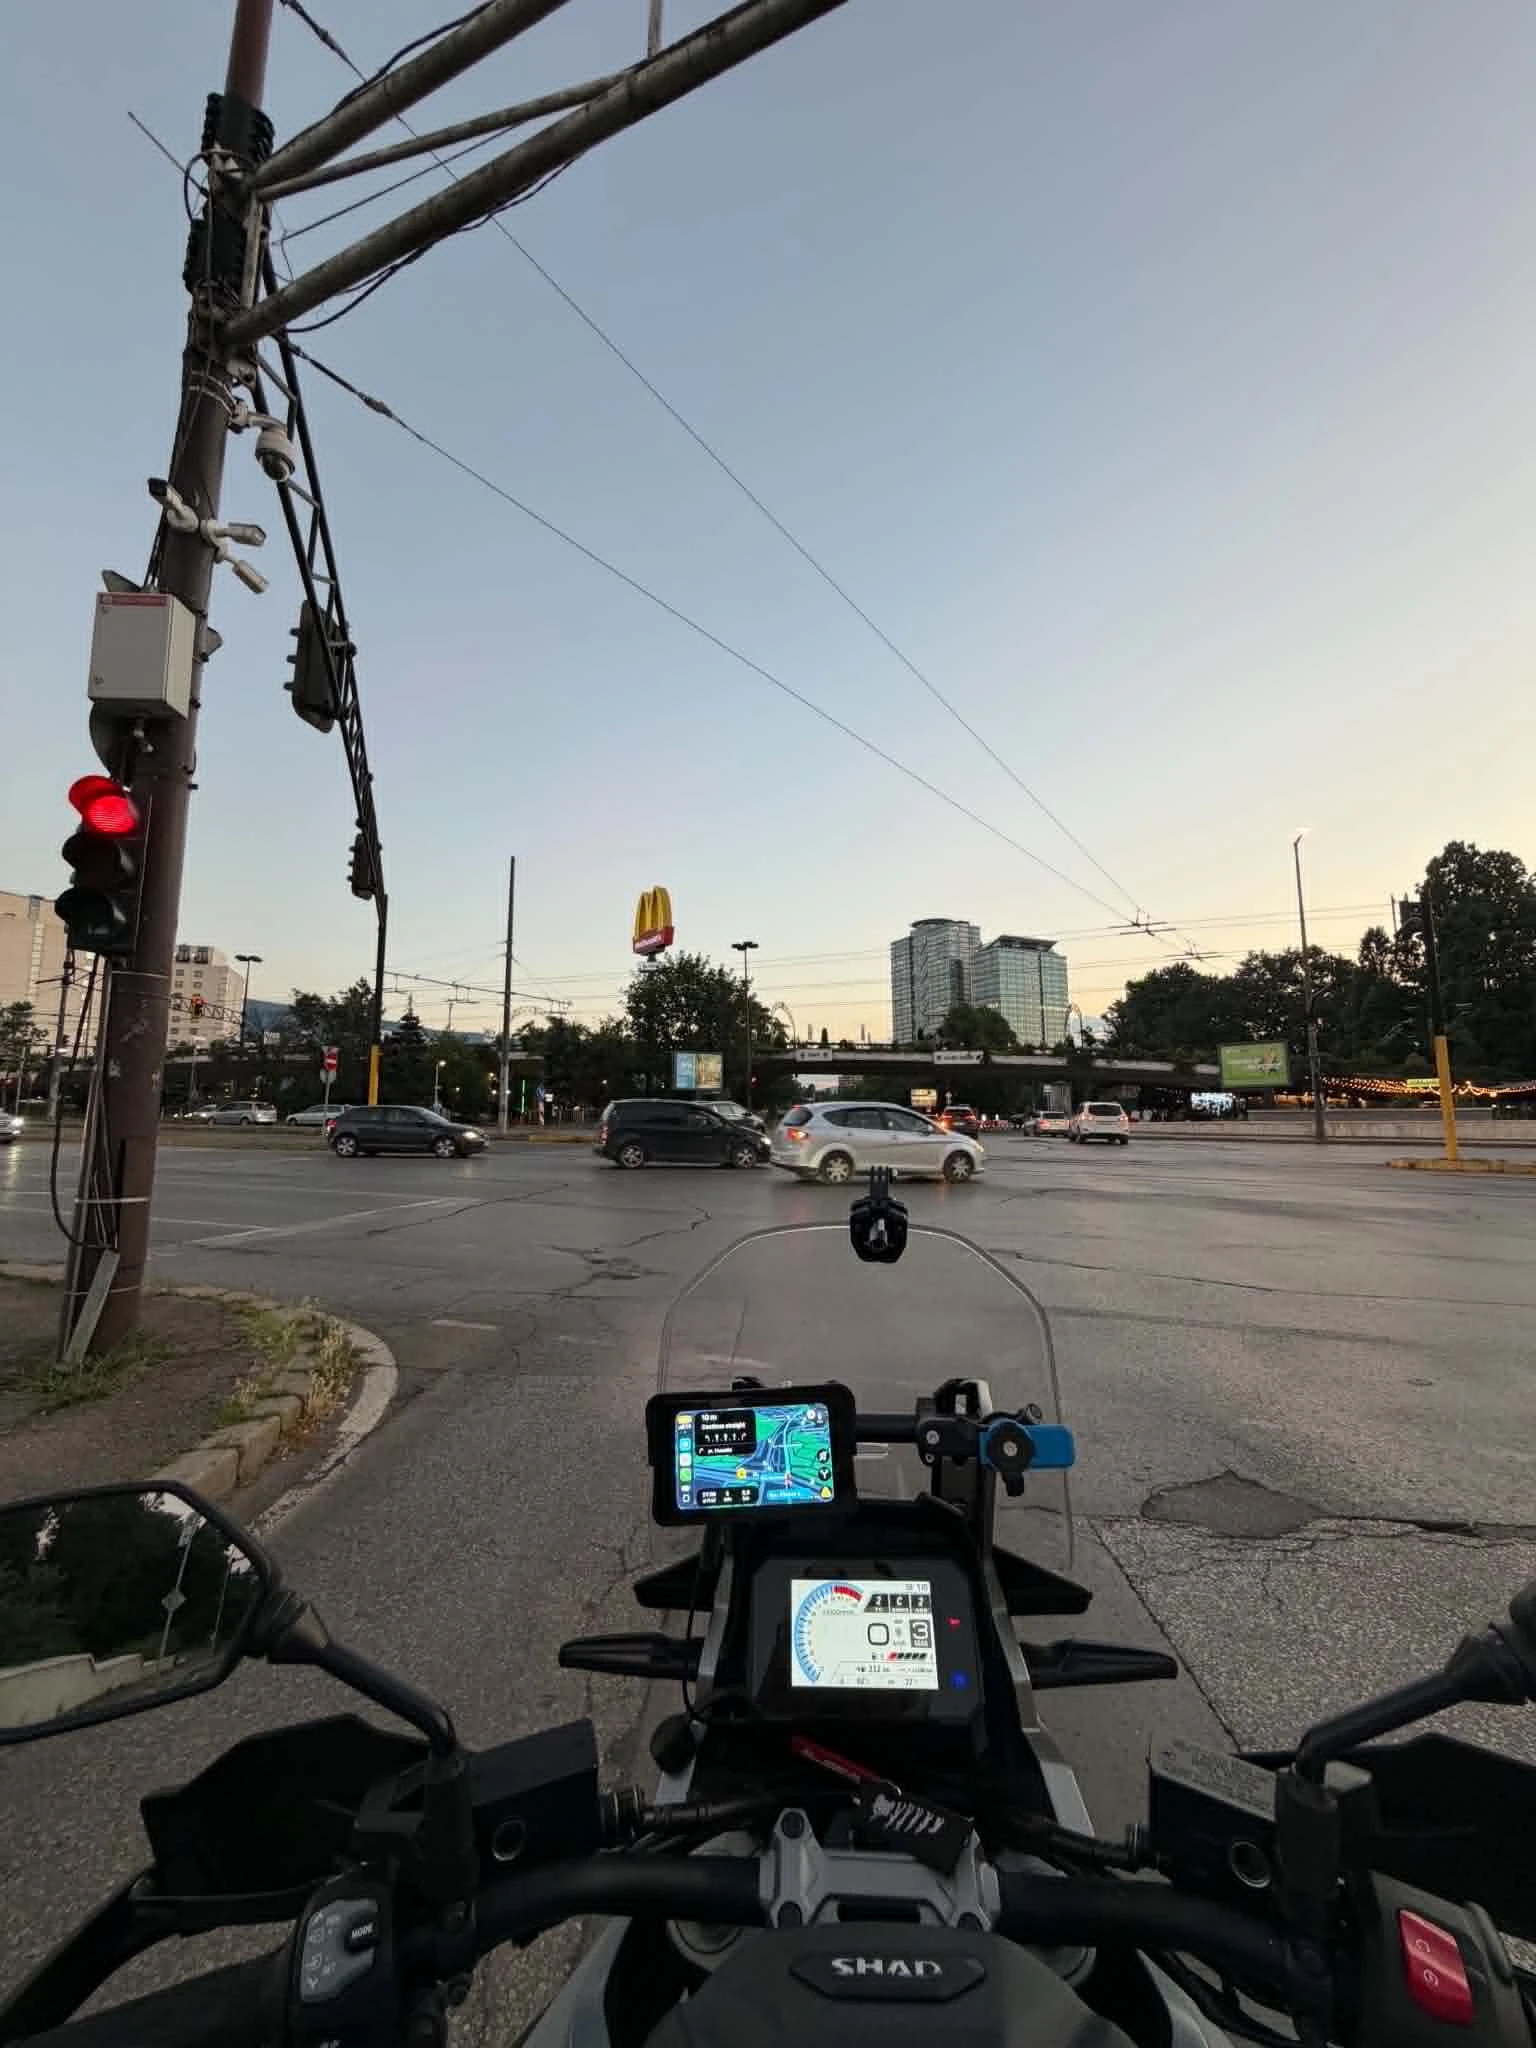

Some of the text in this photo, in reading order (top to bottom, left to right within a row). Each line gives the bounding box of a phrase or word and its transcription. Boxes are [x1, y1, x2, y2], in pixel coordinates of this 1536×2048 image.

[867, 1623, 889, 1645] 0
[912, 1622, 929, 1640] 3
[831, 1957, 943, 1977] SHAD
